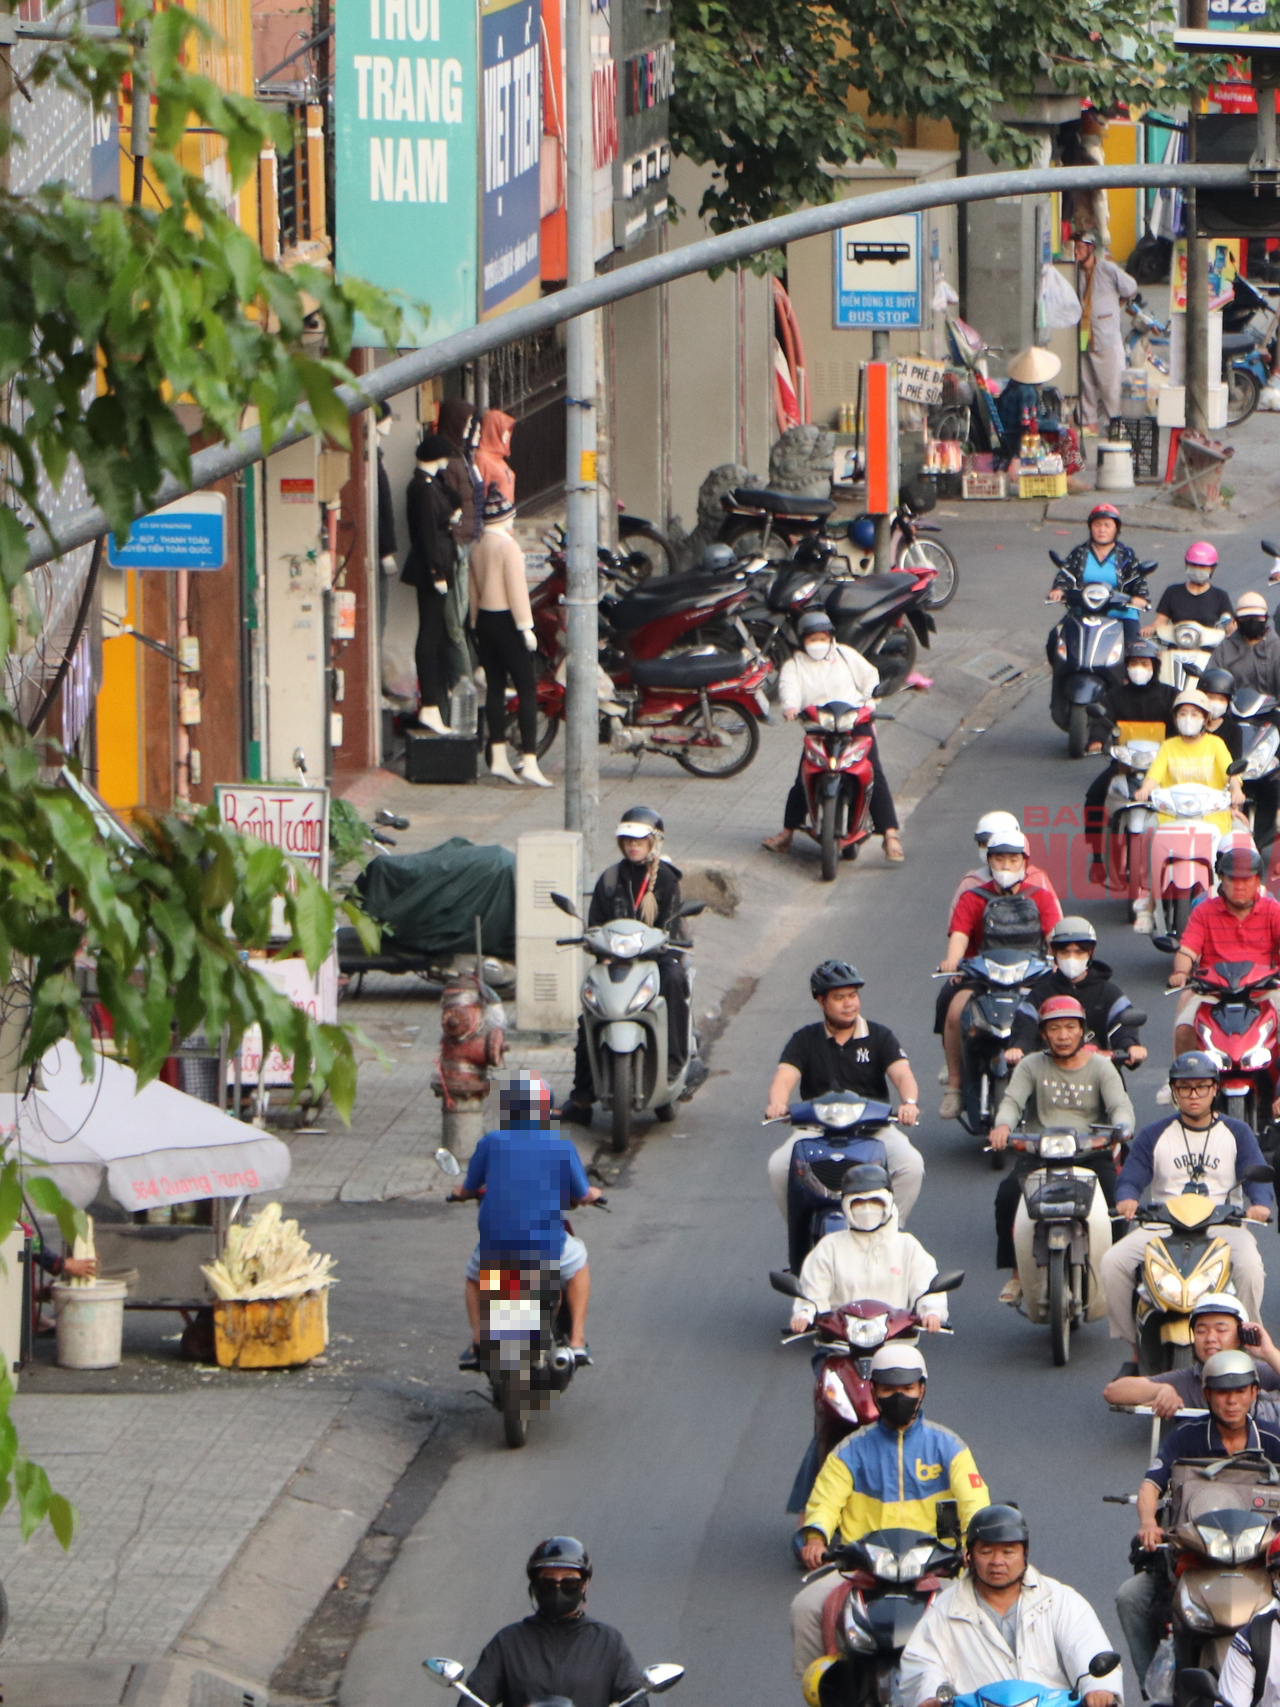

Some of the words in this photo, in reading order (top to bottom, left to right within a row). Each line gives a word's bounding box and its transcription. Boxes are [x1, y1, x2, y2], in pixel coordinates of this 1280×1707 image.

[354, 55, 463, 123] TRANG
[370, 137, 448, 204] NAM
[885, 296, 895, 308] XE
[848, 310, 875, 323] BUS
[877, 311, 910, 323] STOP
[1043, 1079, 1093, 1092] ANYONE
[1052, 1097, 1082, 1107] YOU
[161, 1174, 213, 1196] Quang
[915, 1458, 943, 1482] be
